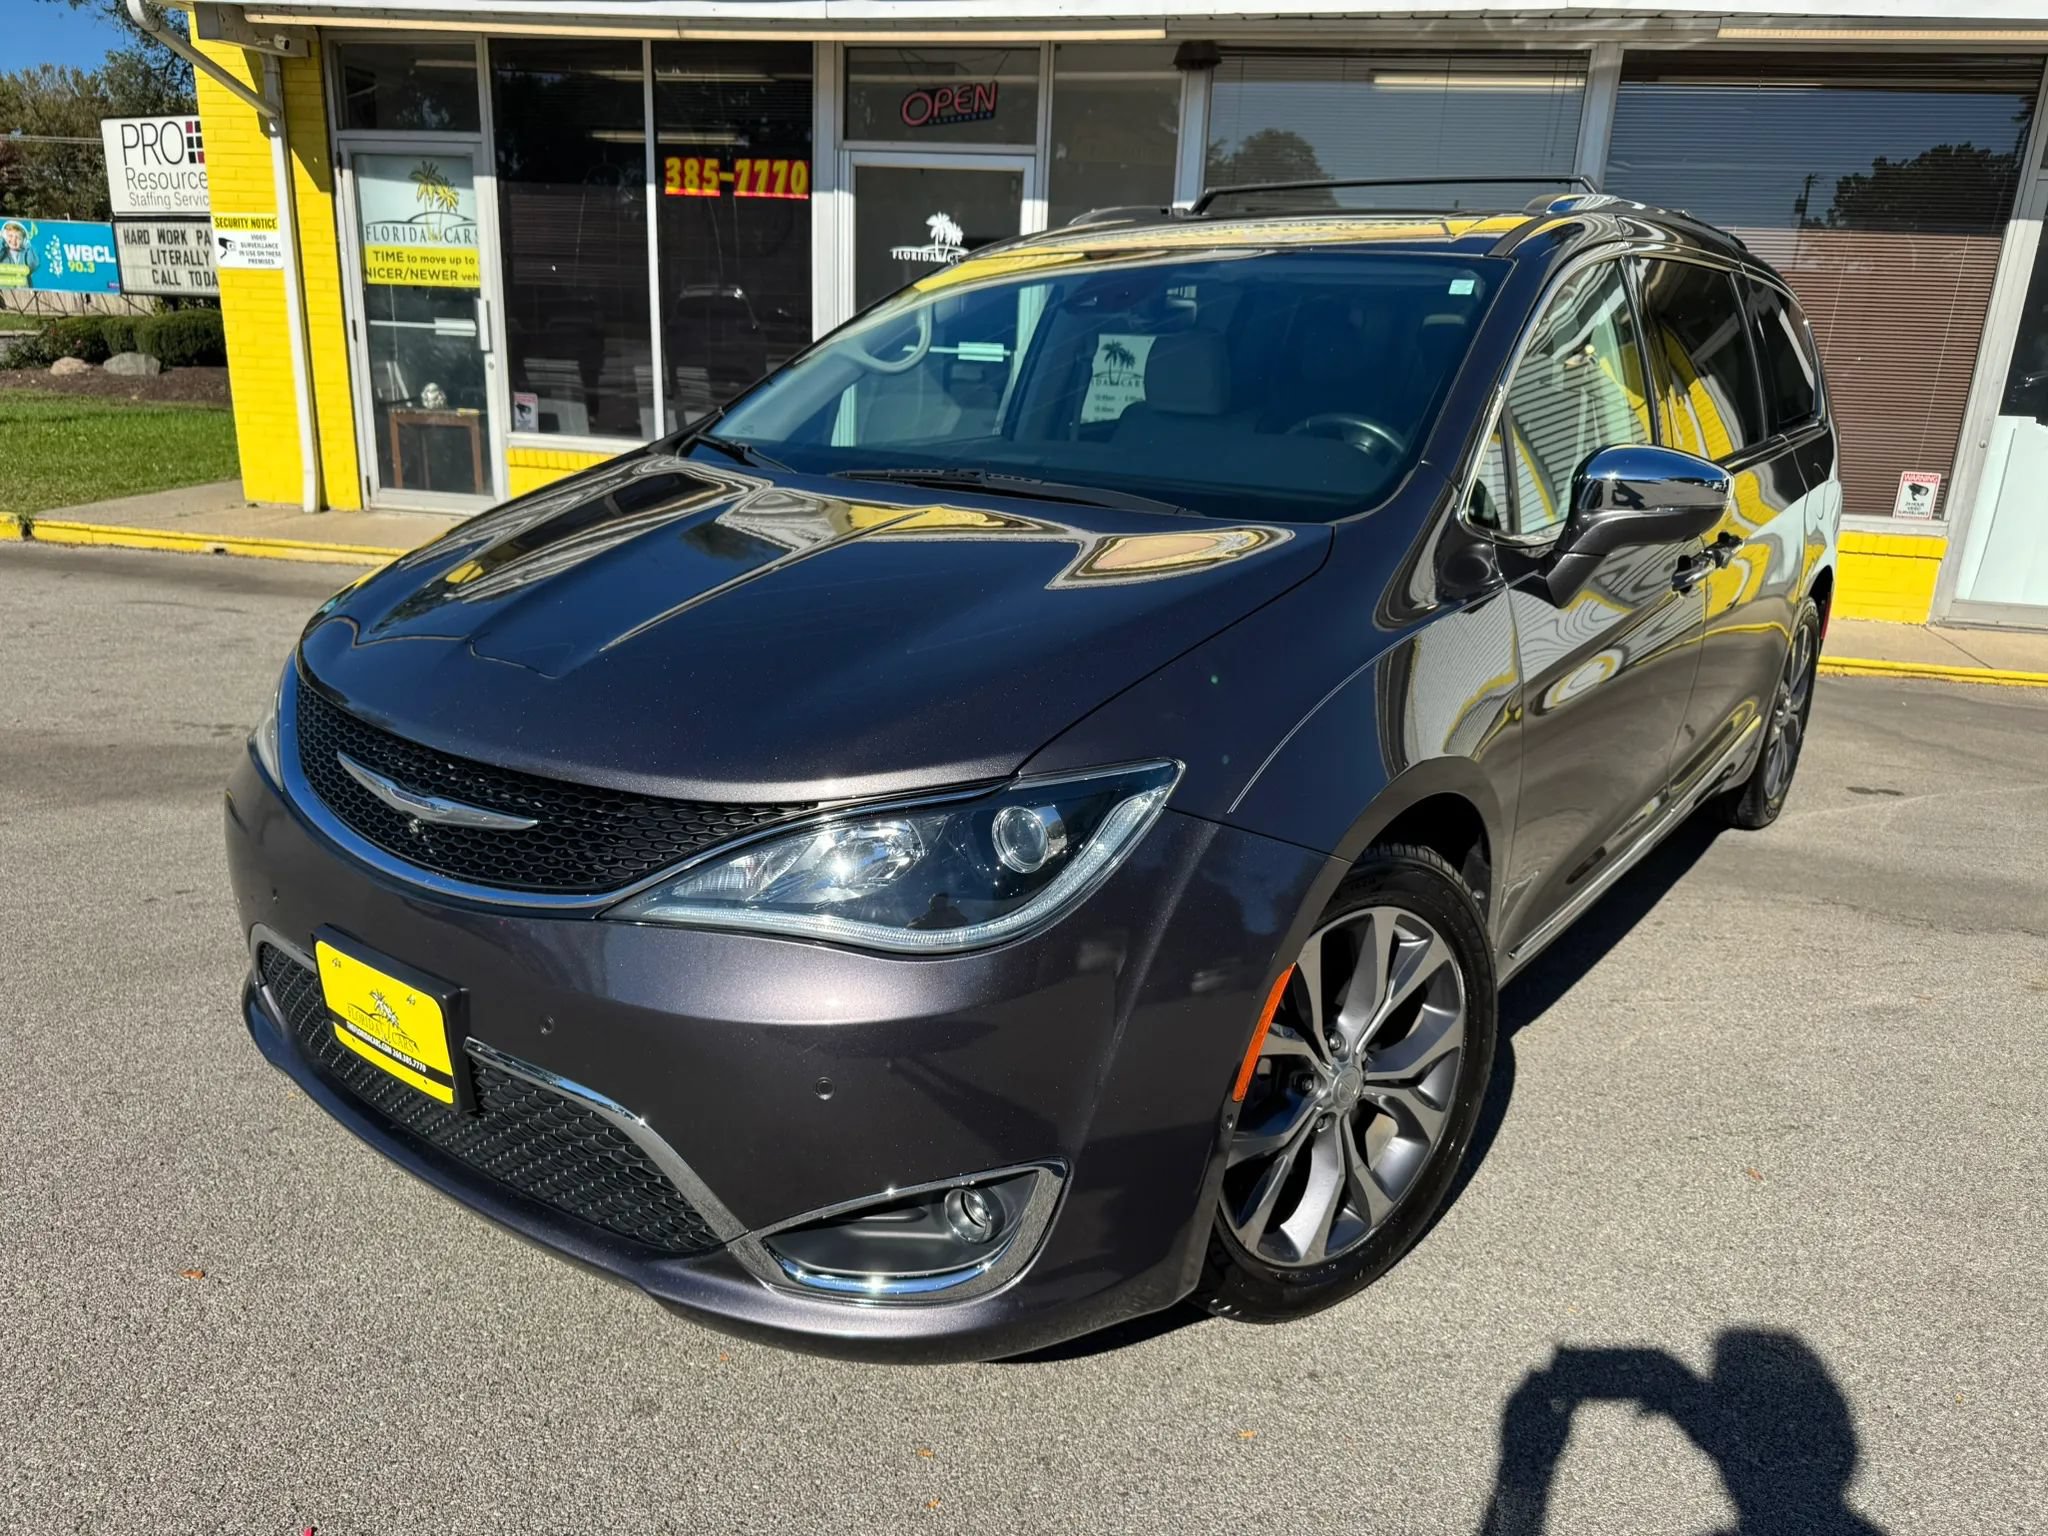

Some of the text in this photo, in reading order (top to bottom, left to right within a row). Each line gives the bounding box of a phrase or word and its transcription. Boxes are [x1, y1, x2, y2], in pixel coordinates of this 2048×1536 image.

[902, 82, 998, 126] OPEN
[121, 121, 184, 166] PRO
[125, 167, 208, 190] Resource
[665, 157, 809, 198] 385-7770
[129, 191, 171, 209] Staffing
[214, 217, 277, 230] SECURITY NOTICE
[123, 228, 150, 245] HARD
[157, 228, 188, 245] WORK
[365, 225, 428, 243] FLORIDA
[63, 244, 116, 263] WBCL
[149, 249, 210, 266] LITERALLY
[373, 250, 476, 266] TIME to move up to
[68, 260, 96, 273] 90.3
[152, 269, 182, 286] CALL
